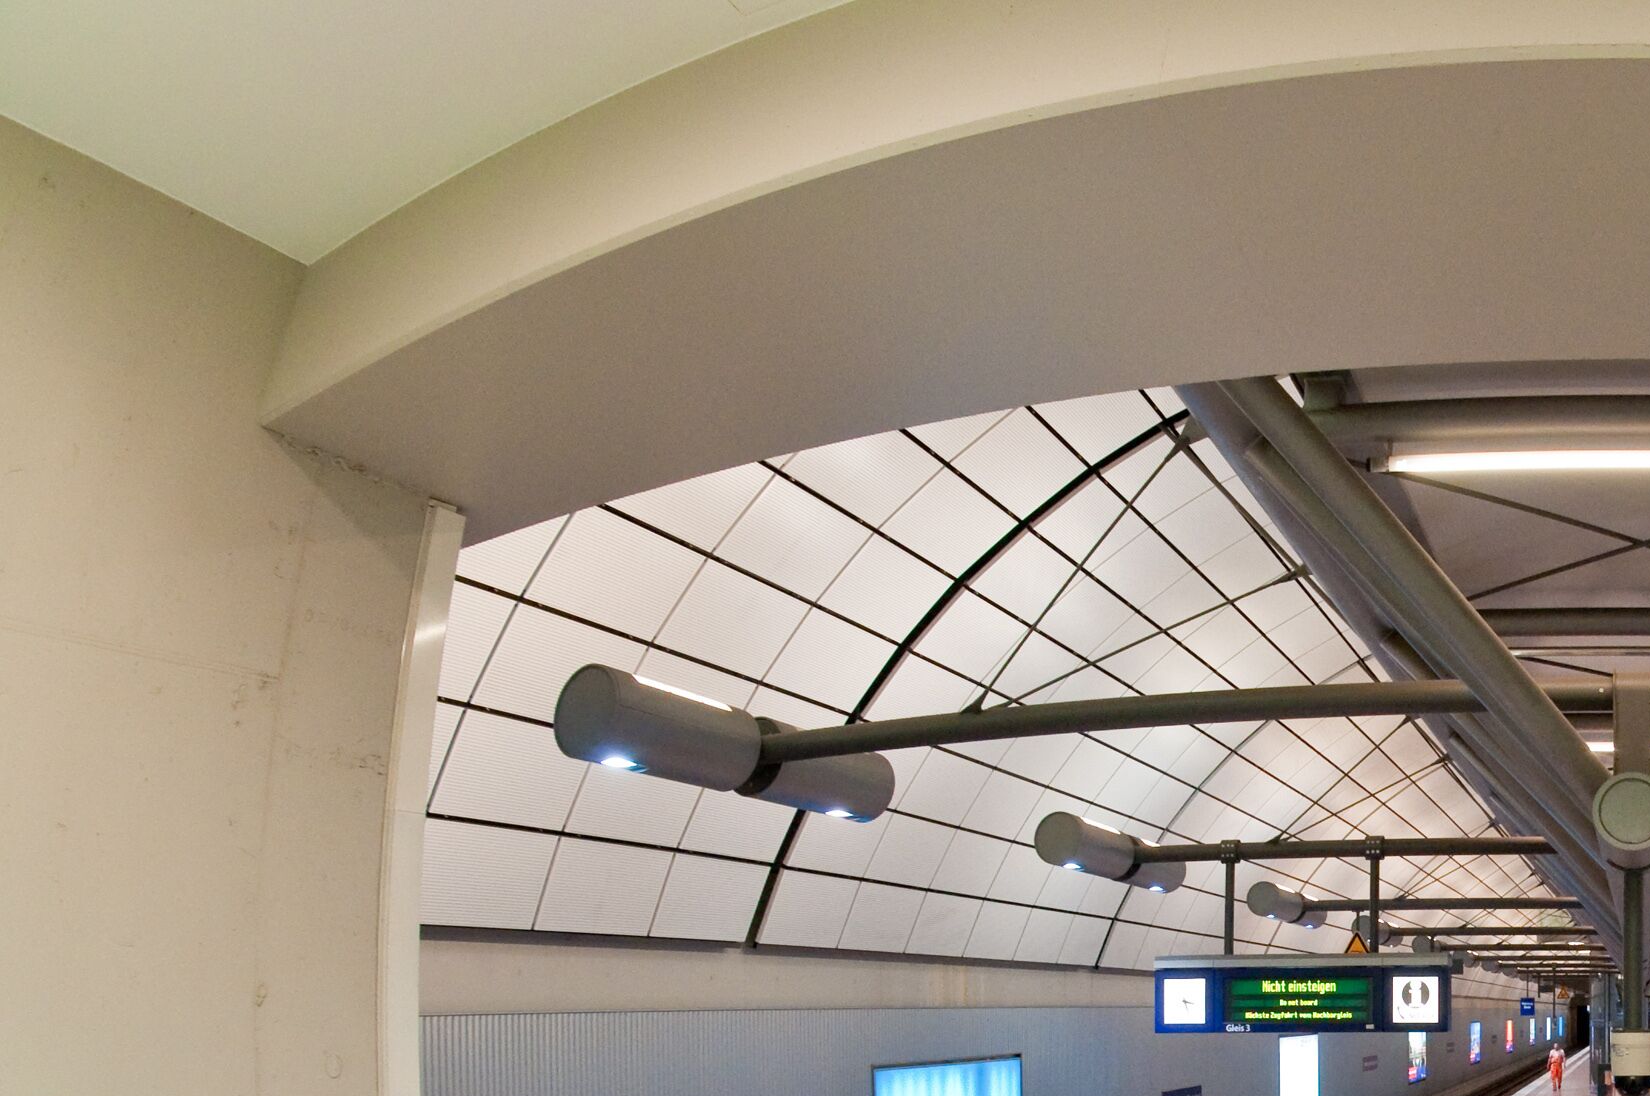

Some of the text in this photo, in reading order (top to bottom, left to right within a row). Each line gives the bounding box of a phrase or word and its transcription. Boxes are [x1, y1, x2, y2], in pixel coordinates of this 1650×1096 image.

[1262, 980, 1337, 995] Nicht einsteigen
[1225, 1024, 1251, 1032] Gleis 3
